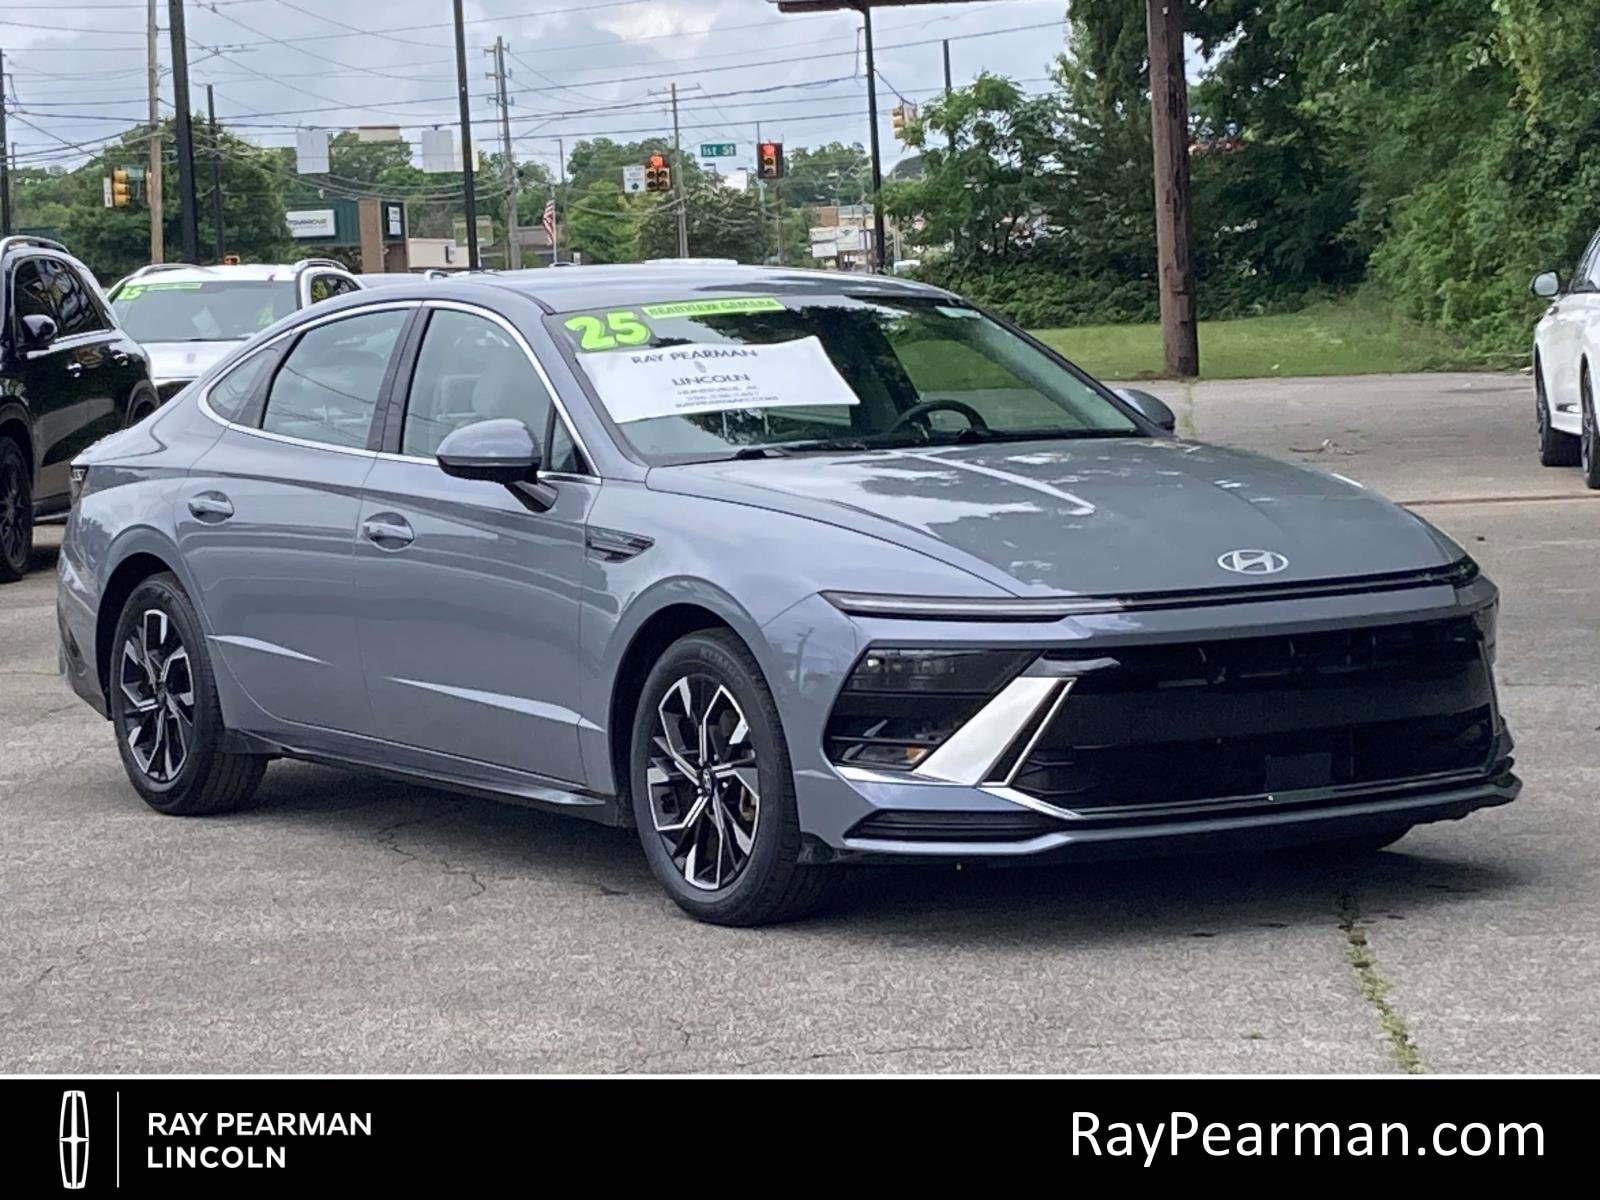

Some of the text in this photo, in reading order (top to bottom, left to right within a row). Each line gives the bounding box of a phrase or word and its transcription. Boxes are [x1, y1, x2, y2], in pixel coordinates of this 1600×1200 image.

[564, 311, 651, 350] 25
[631, 349, 758, 364] RAY PEARMAN
[671, 373, 751, 386] LINCOLN
